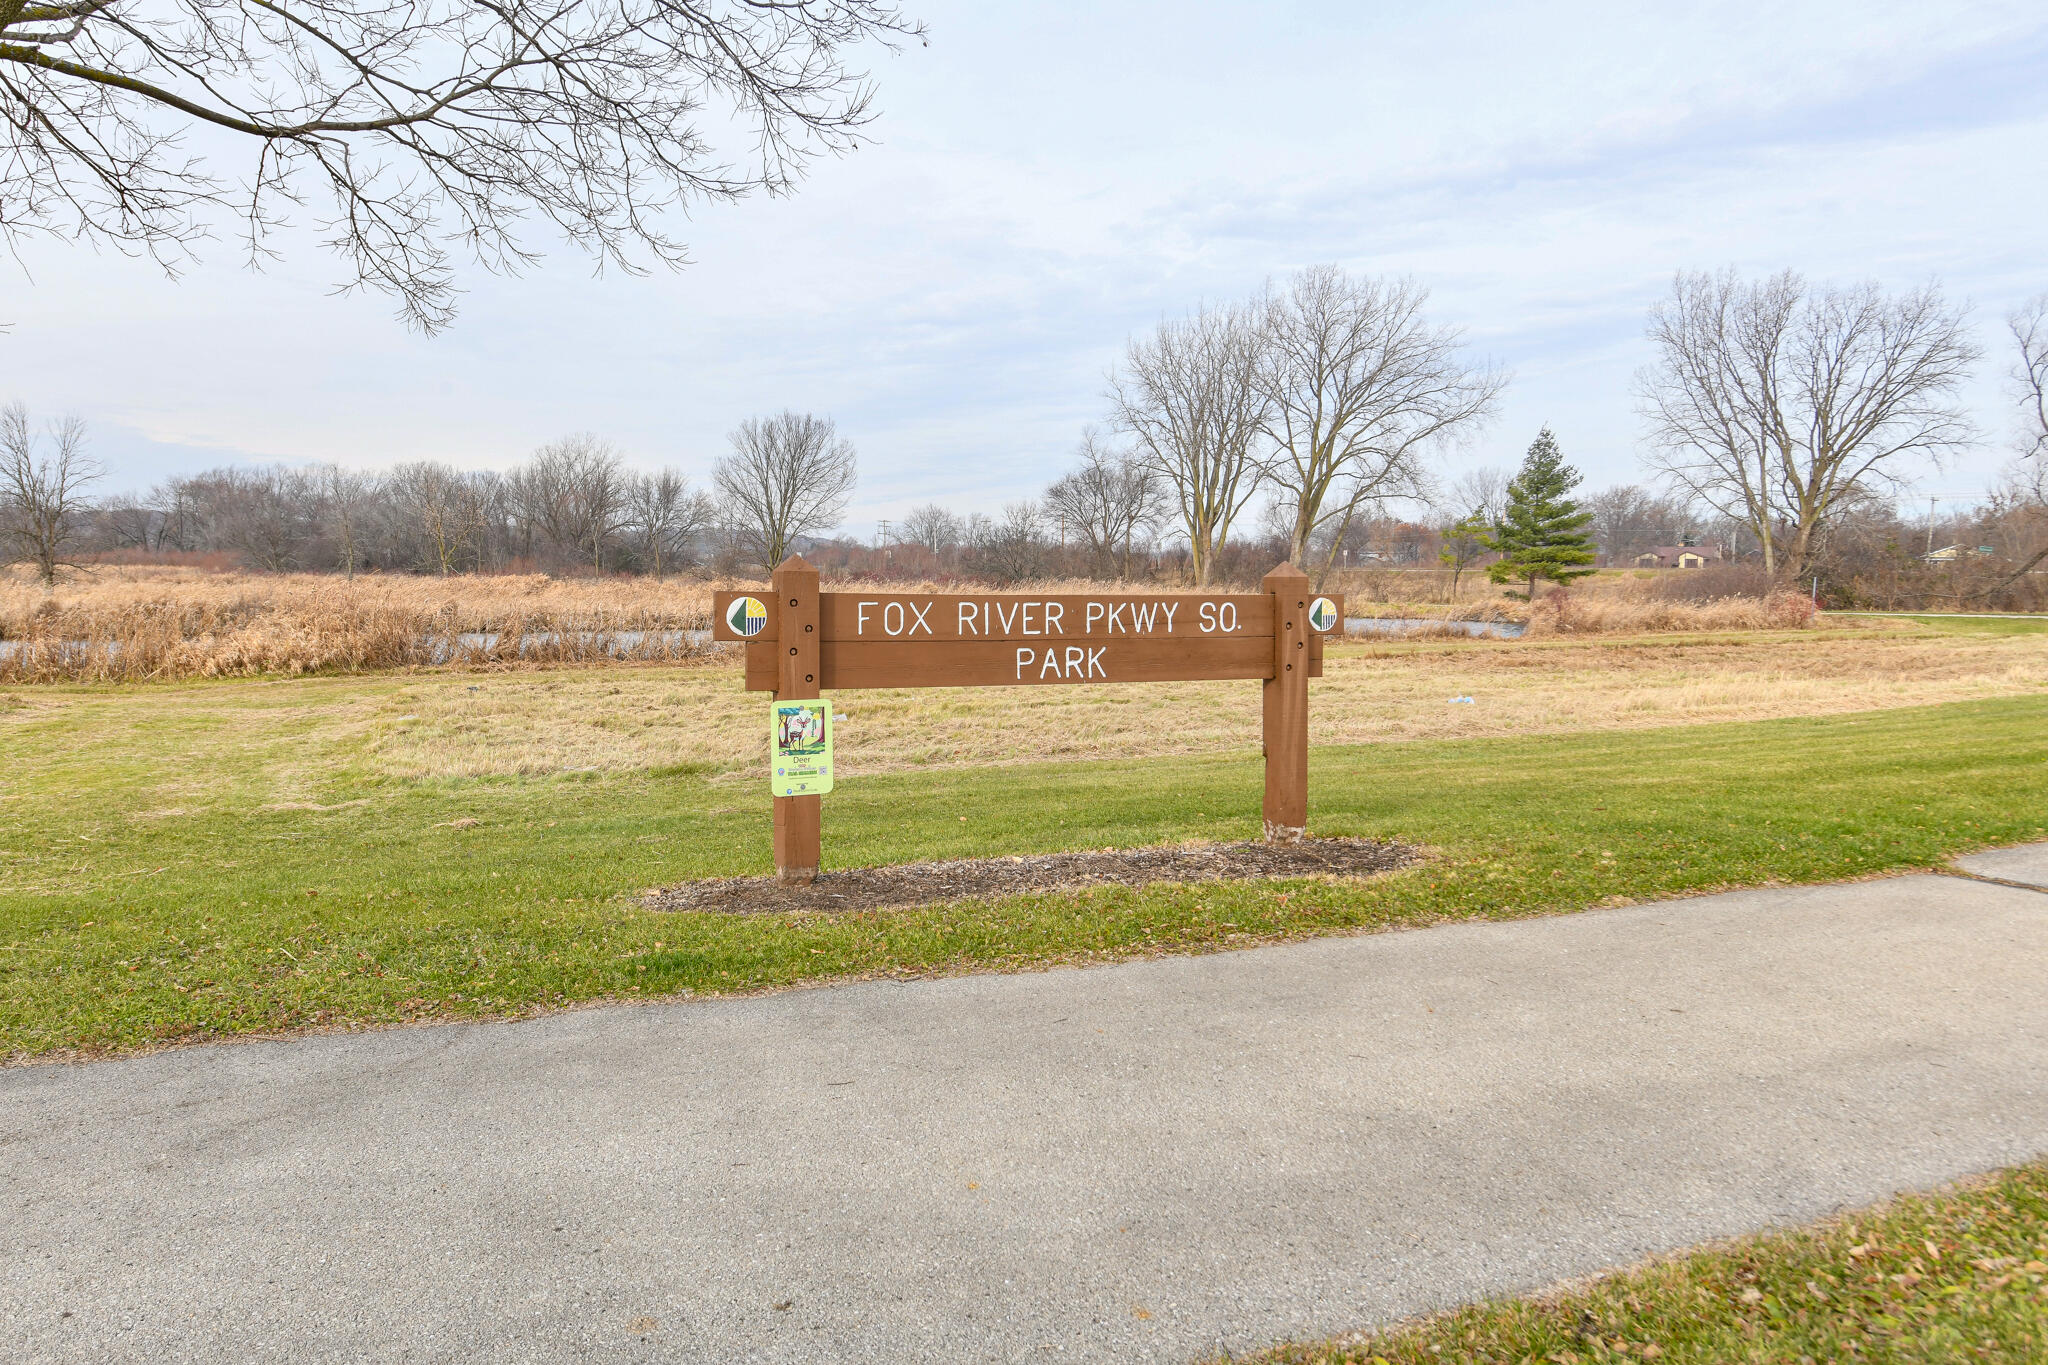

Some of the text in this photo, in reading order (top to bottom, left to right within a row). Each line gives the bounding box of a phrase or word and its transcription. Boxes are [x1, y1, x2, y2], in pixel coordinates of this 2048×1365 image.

[858, 601, 1242, 636] FOX RIVER PKWY SO.
[1016, 646, 1107, 680] PARK
[793, 756, 811, 764] Deer
